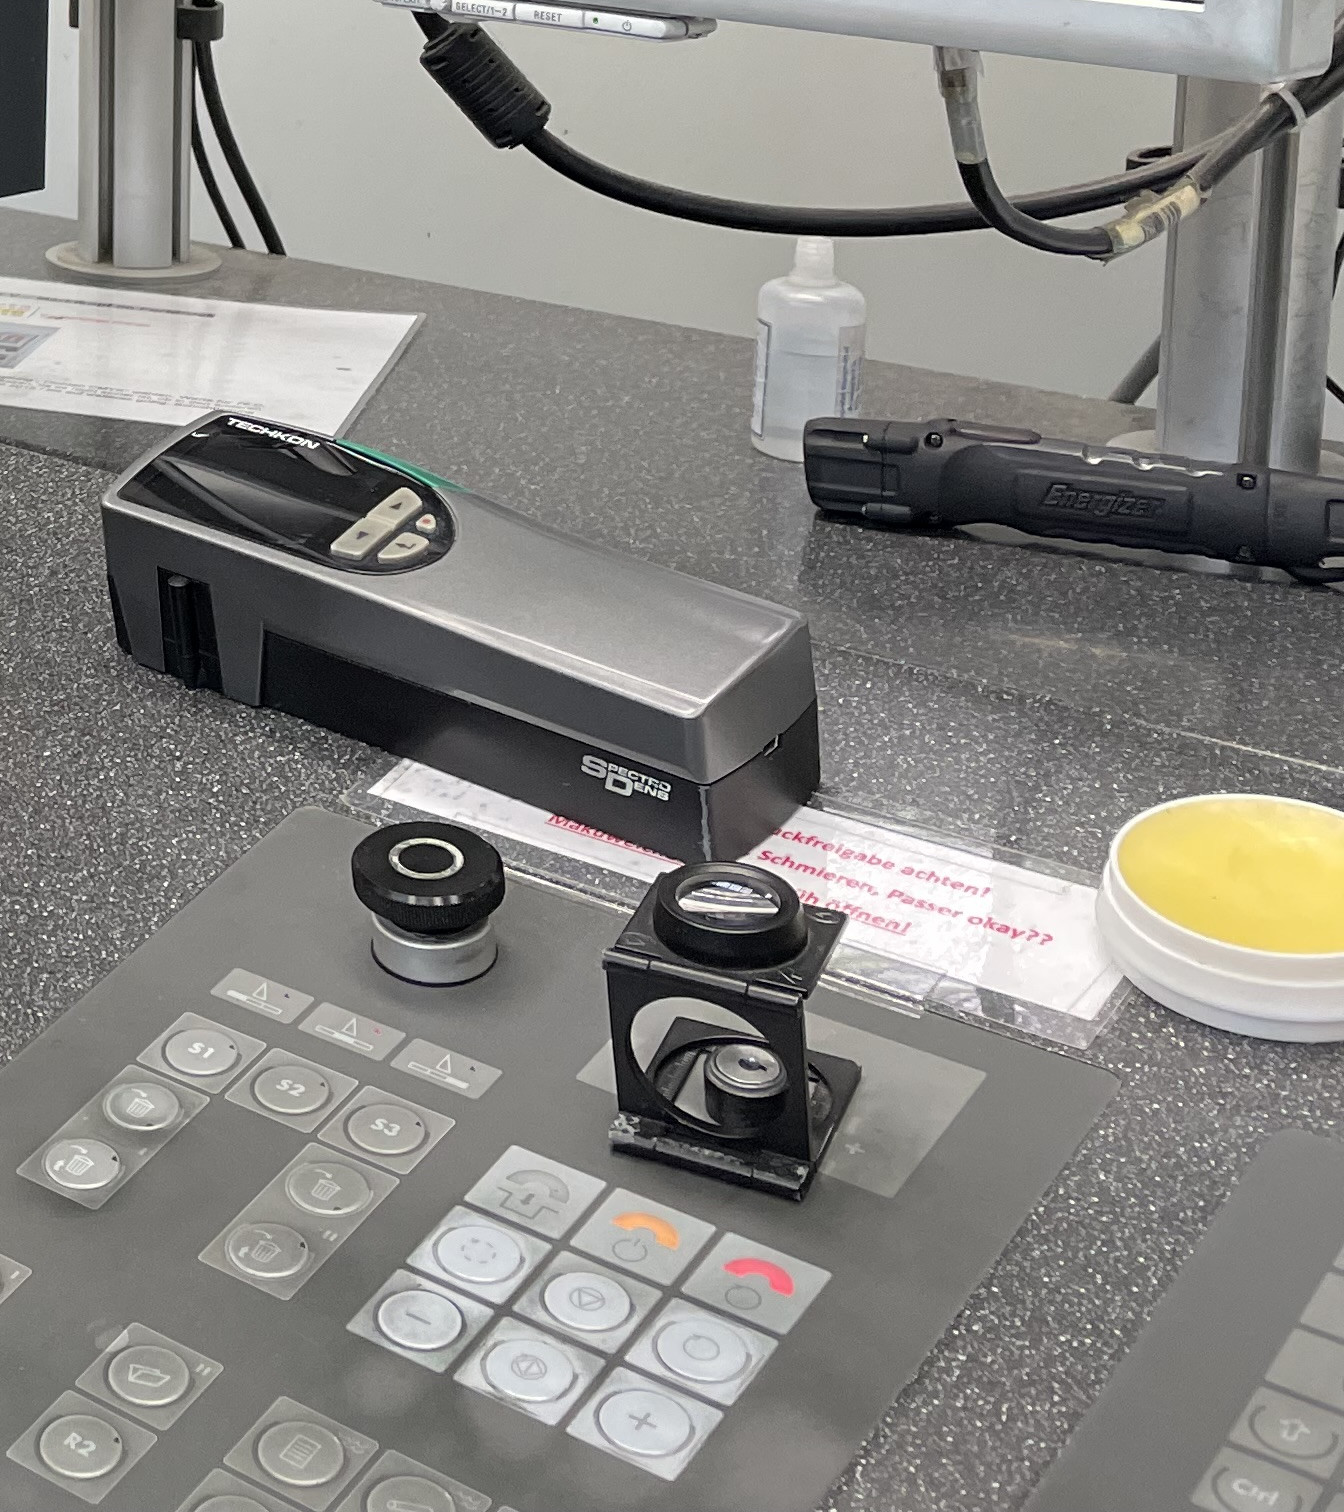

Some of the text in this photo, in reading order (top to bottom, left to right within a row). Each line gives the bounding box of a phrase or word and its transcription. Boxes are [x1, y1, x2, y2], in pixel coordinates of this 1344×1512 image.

[533, 10, 563, 23] RESET
[225, 416, 320, 451] TECHKON
[900, 864, 991, 899] achten!
[887, 888, 964, 921] Passer
[967, 913, 1054, 947] okay??
[187, 1042, 215, 1059] S1
[275, 1079, 306, 1097] S2
[370, 1118, 402, 1137] S3
[63, 1431, 97, 1458] R2
